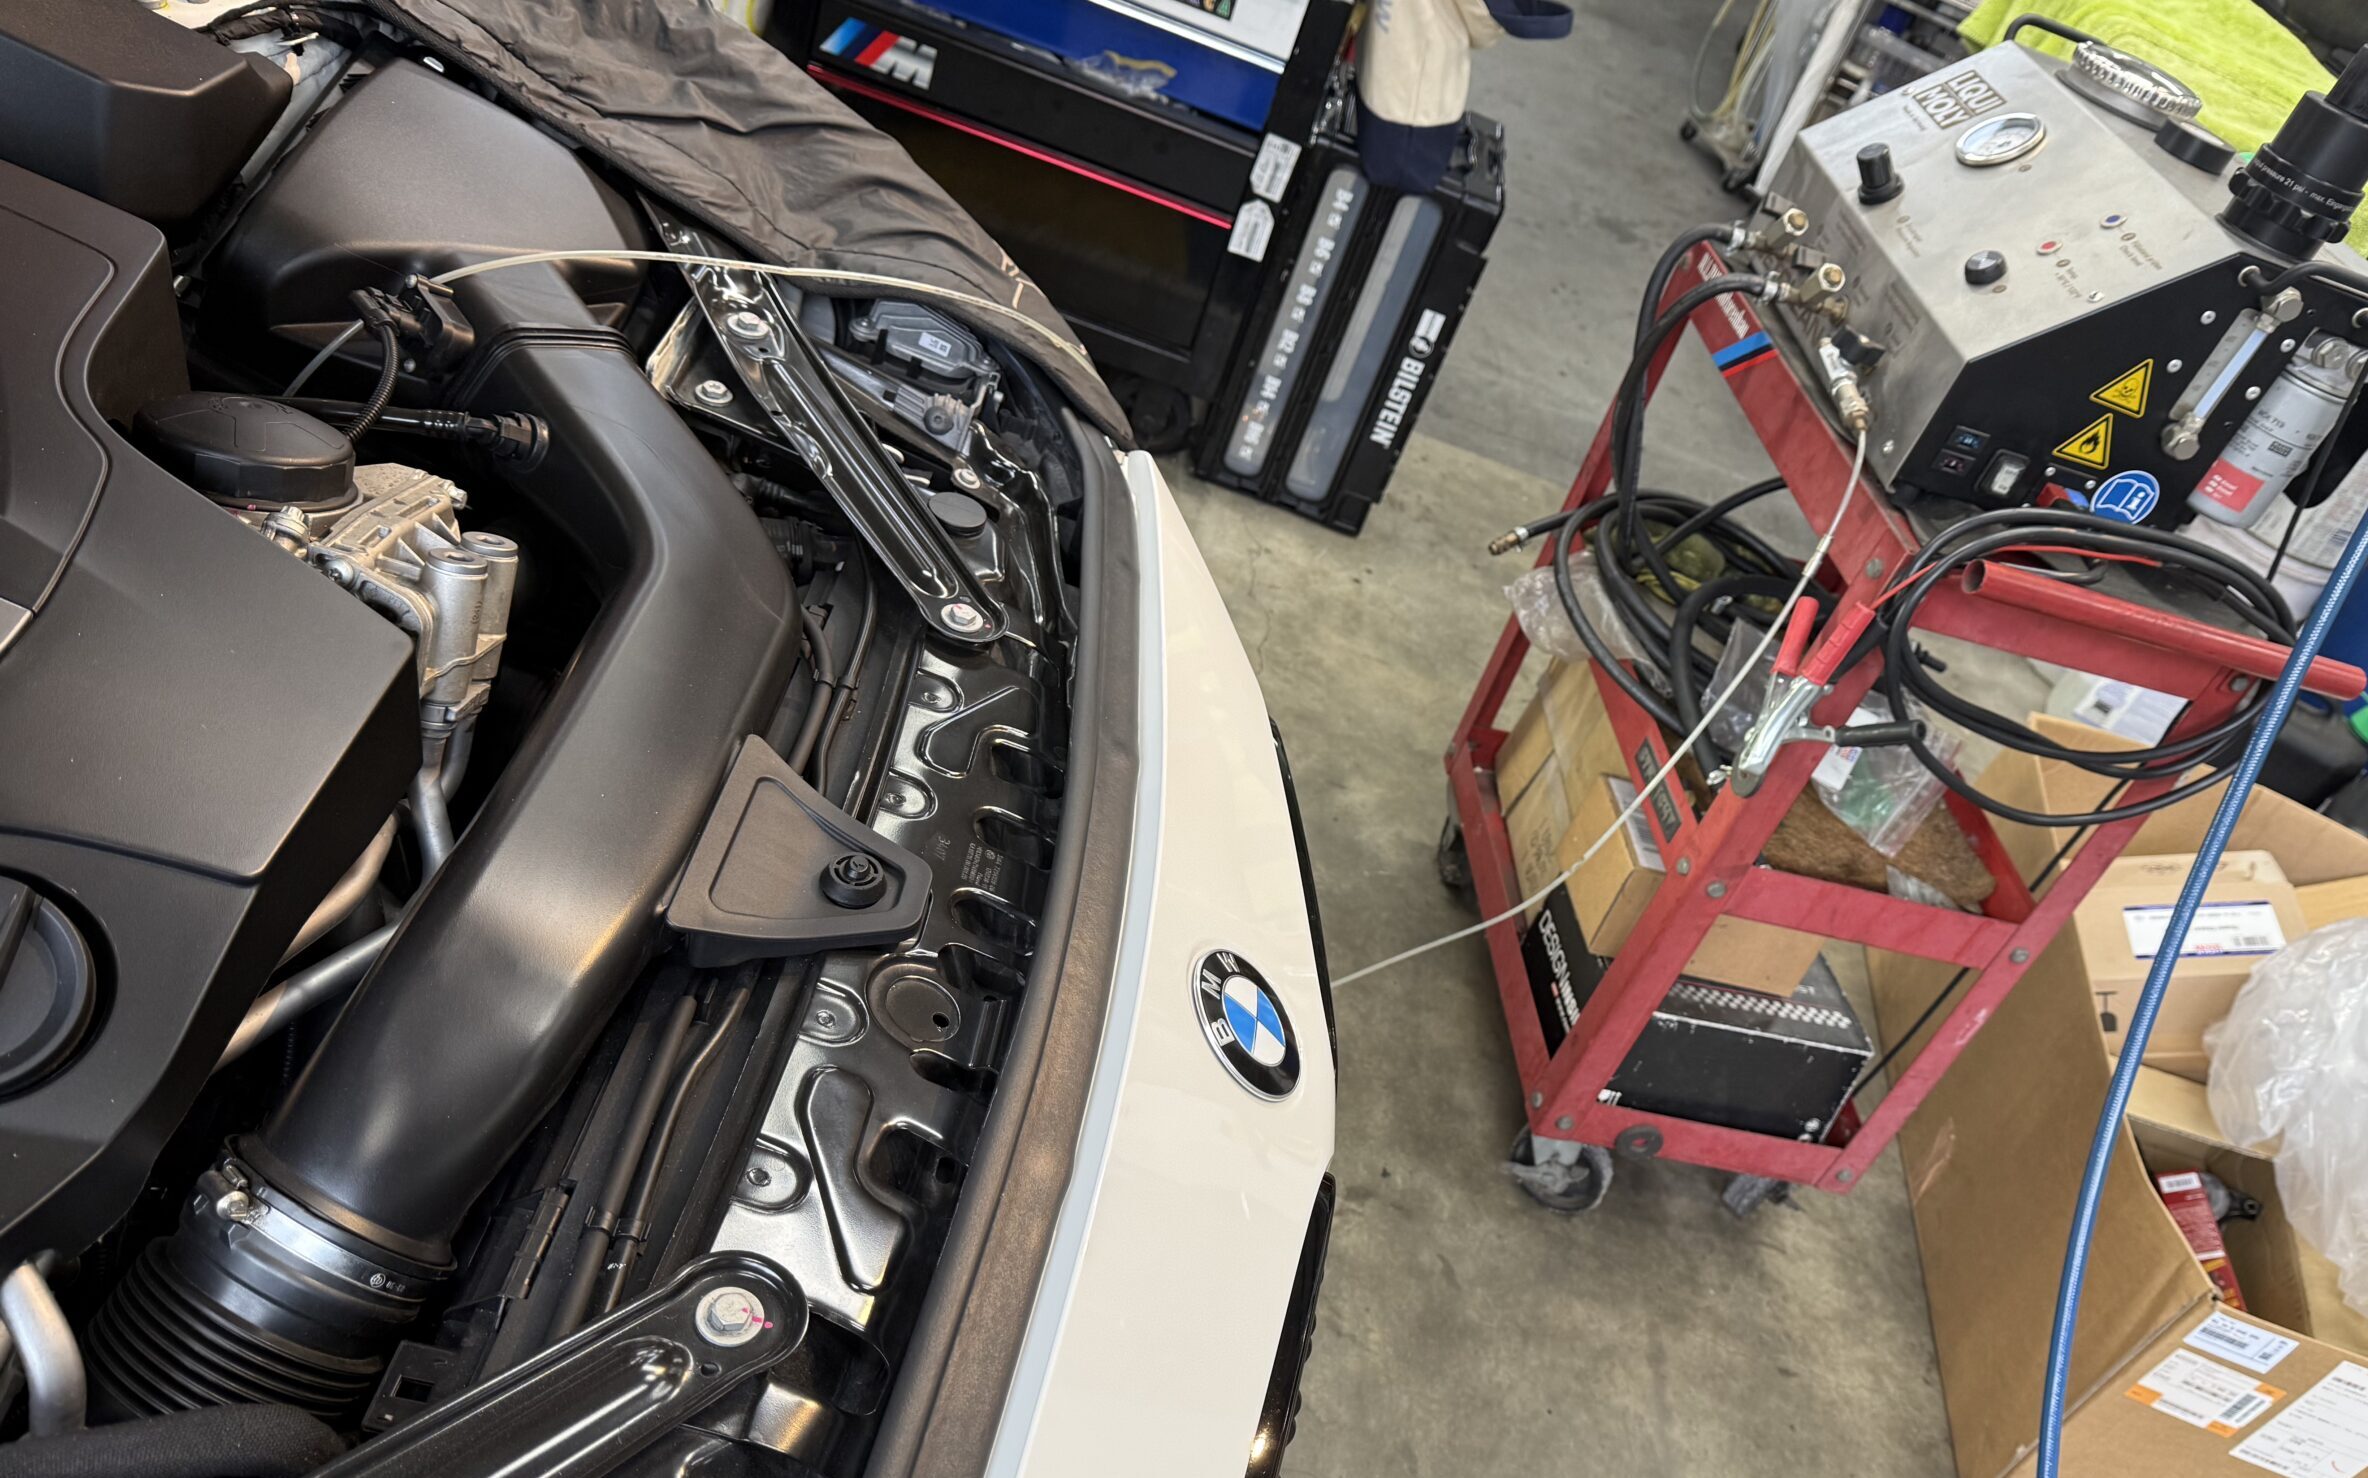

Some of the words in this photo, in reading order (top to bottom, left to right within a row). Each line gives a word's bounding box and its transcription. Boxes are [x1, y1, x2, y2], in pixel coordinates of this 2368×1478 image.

[1915, 85, 1971, 128] MOLY
[1948, 70, 2004, 115] LIQUI
[2284, 178, 2295, 188] 21
[1369, 356, 1426, 448] BILSTEIN
[1201, 952, 1241, 1046] BMW
